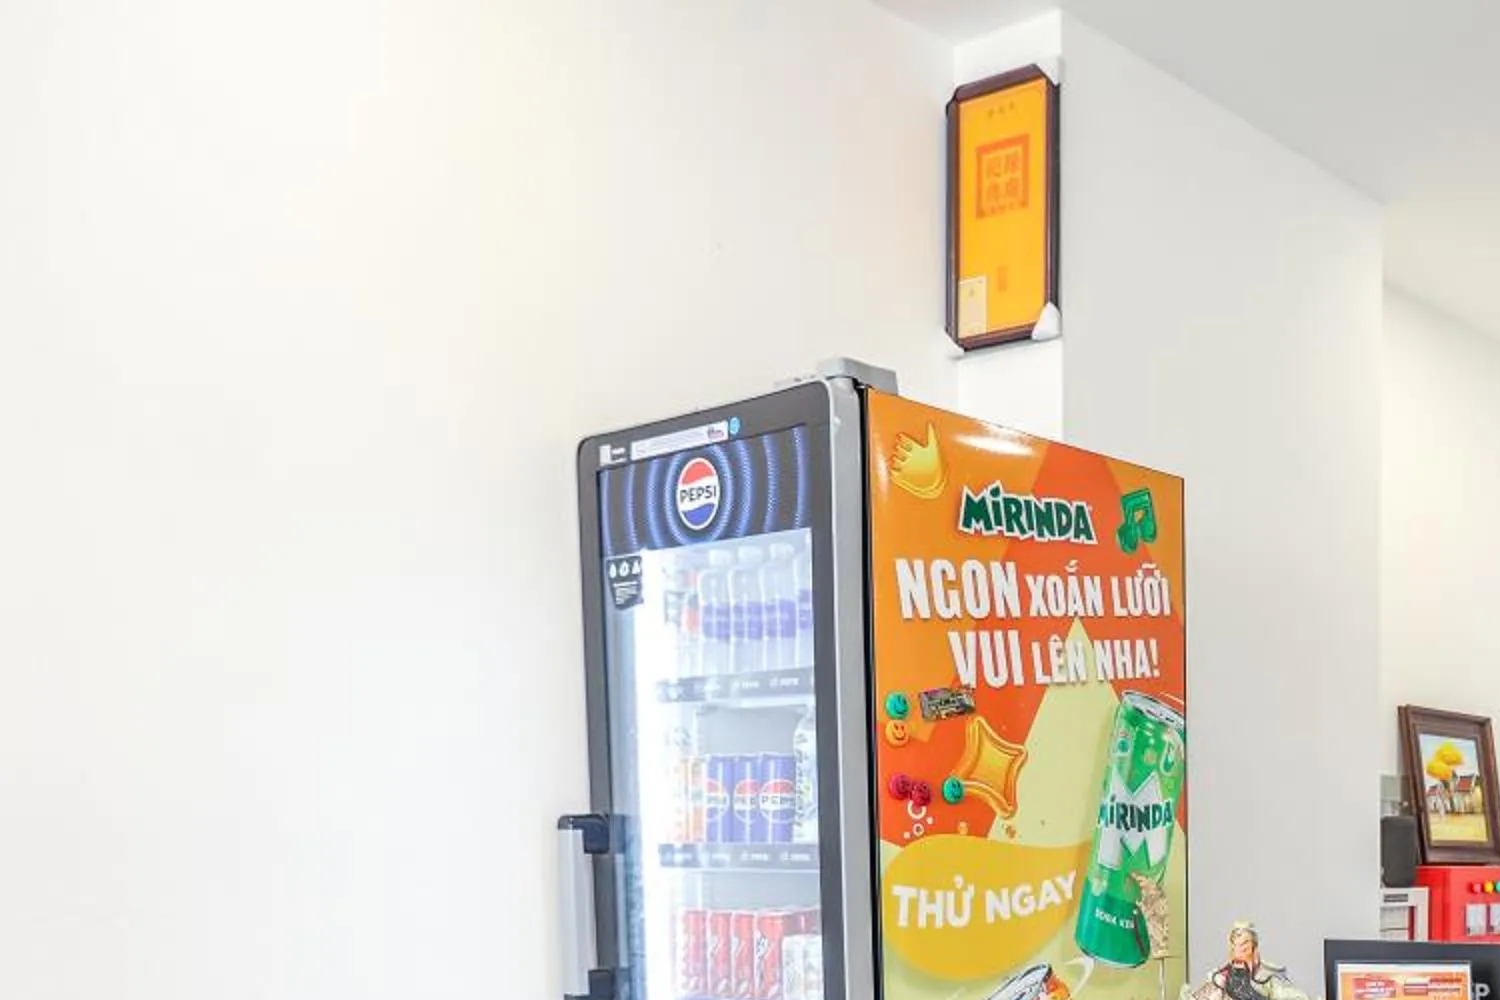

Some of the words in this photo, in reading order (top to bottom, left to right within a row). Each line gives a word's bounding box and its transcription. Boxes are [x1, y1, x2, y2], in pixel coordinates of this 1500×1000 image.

[679, 485, 717, 503] PEPSI
[895, 559, 1021, 619] NGON
[1026, 560, 1104, 617] XOẮN
[1111, 562, 1171, 617] LƯỠI
[948, 630, 1024, 689] VUI
[1032, 634, 1087, 683] LÊN
[1093, 638, 1160, 681] NHA!
[892, 875, 975, 930] THỬ
[985, 870, 1077, 924] NGAY
